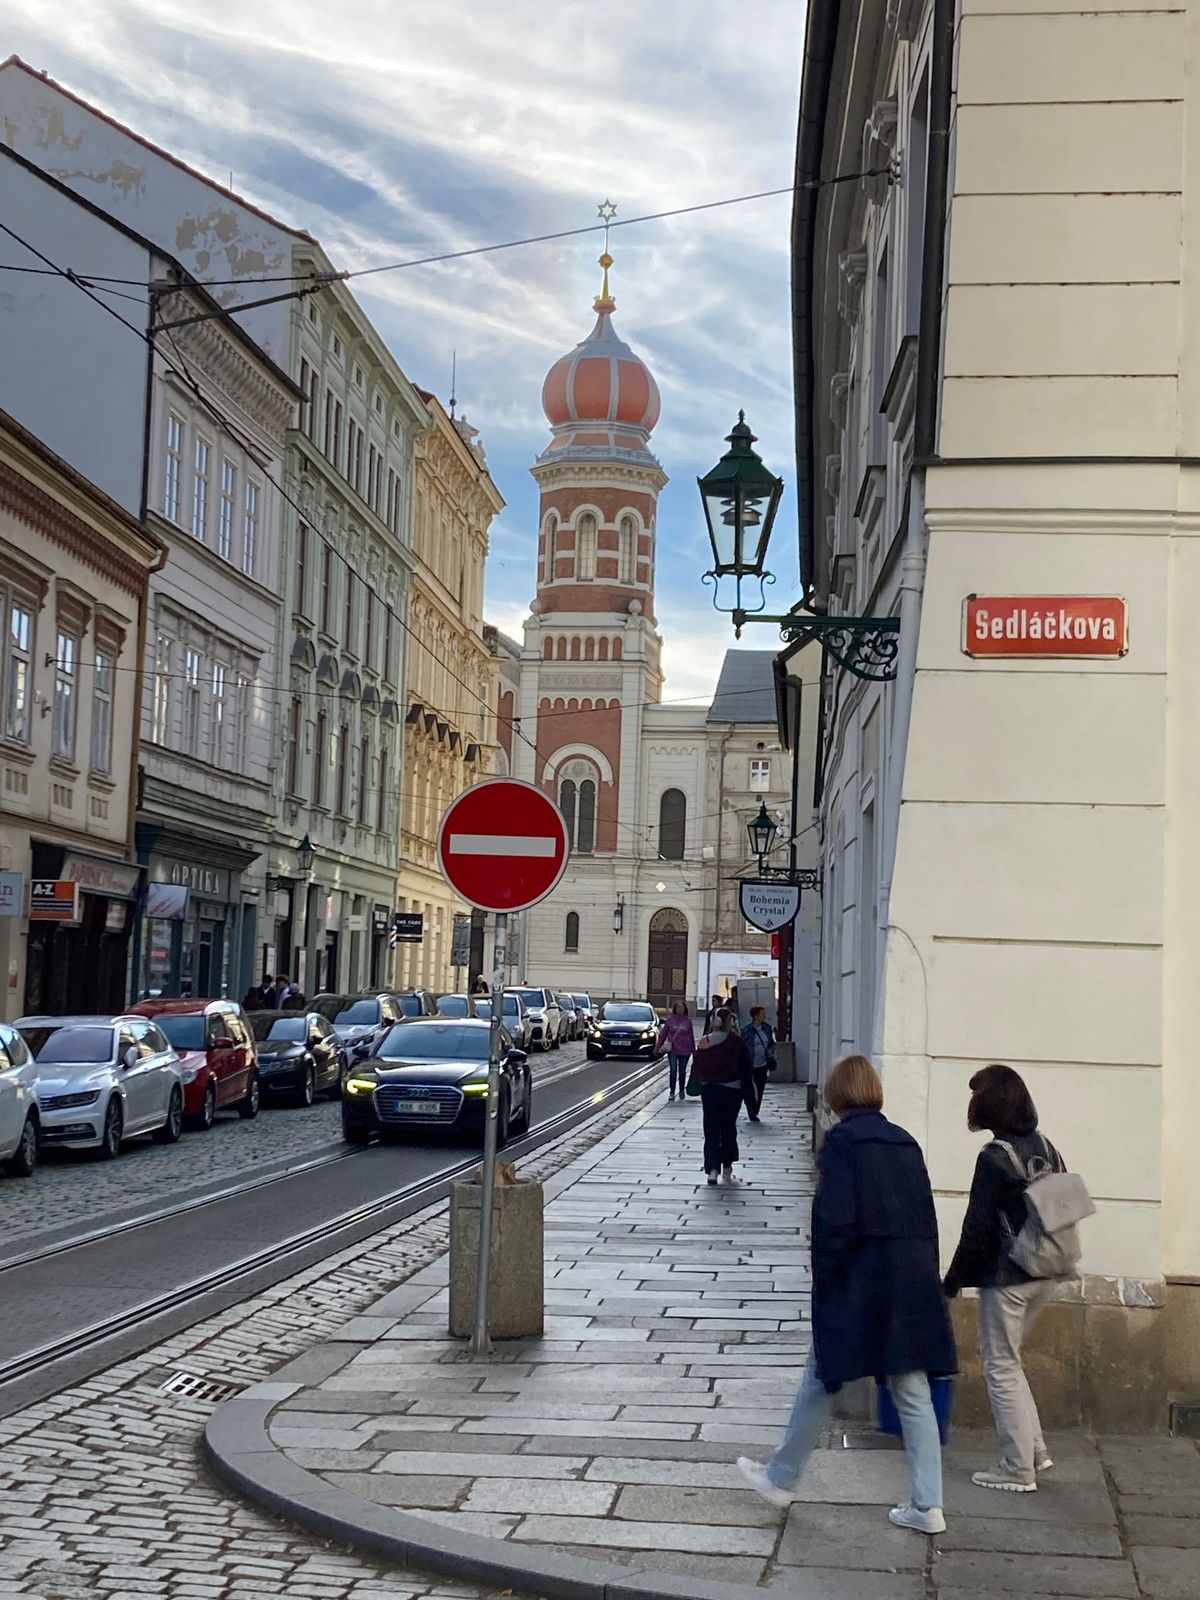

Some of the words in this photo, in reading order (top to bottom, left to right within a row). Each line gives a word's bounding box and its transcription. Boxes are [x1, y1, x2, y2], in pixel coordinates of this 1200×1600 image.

[975, 609, 1115, 640] Sedláčkova
[172, 863, 219, 894] OPTIKA
[33, 883, 55, 896] A-Z
[750, 895, 790, 905] Bohemia
[753, 905, 785, 916] Crystal
